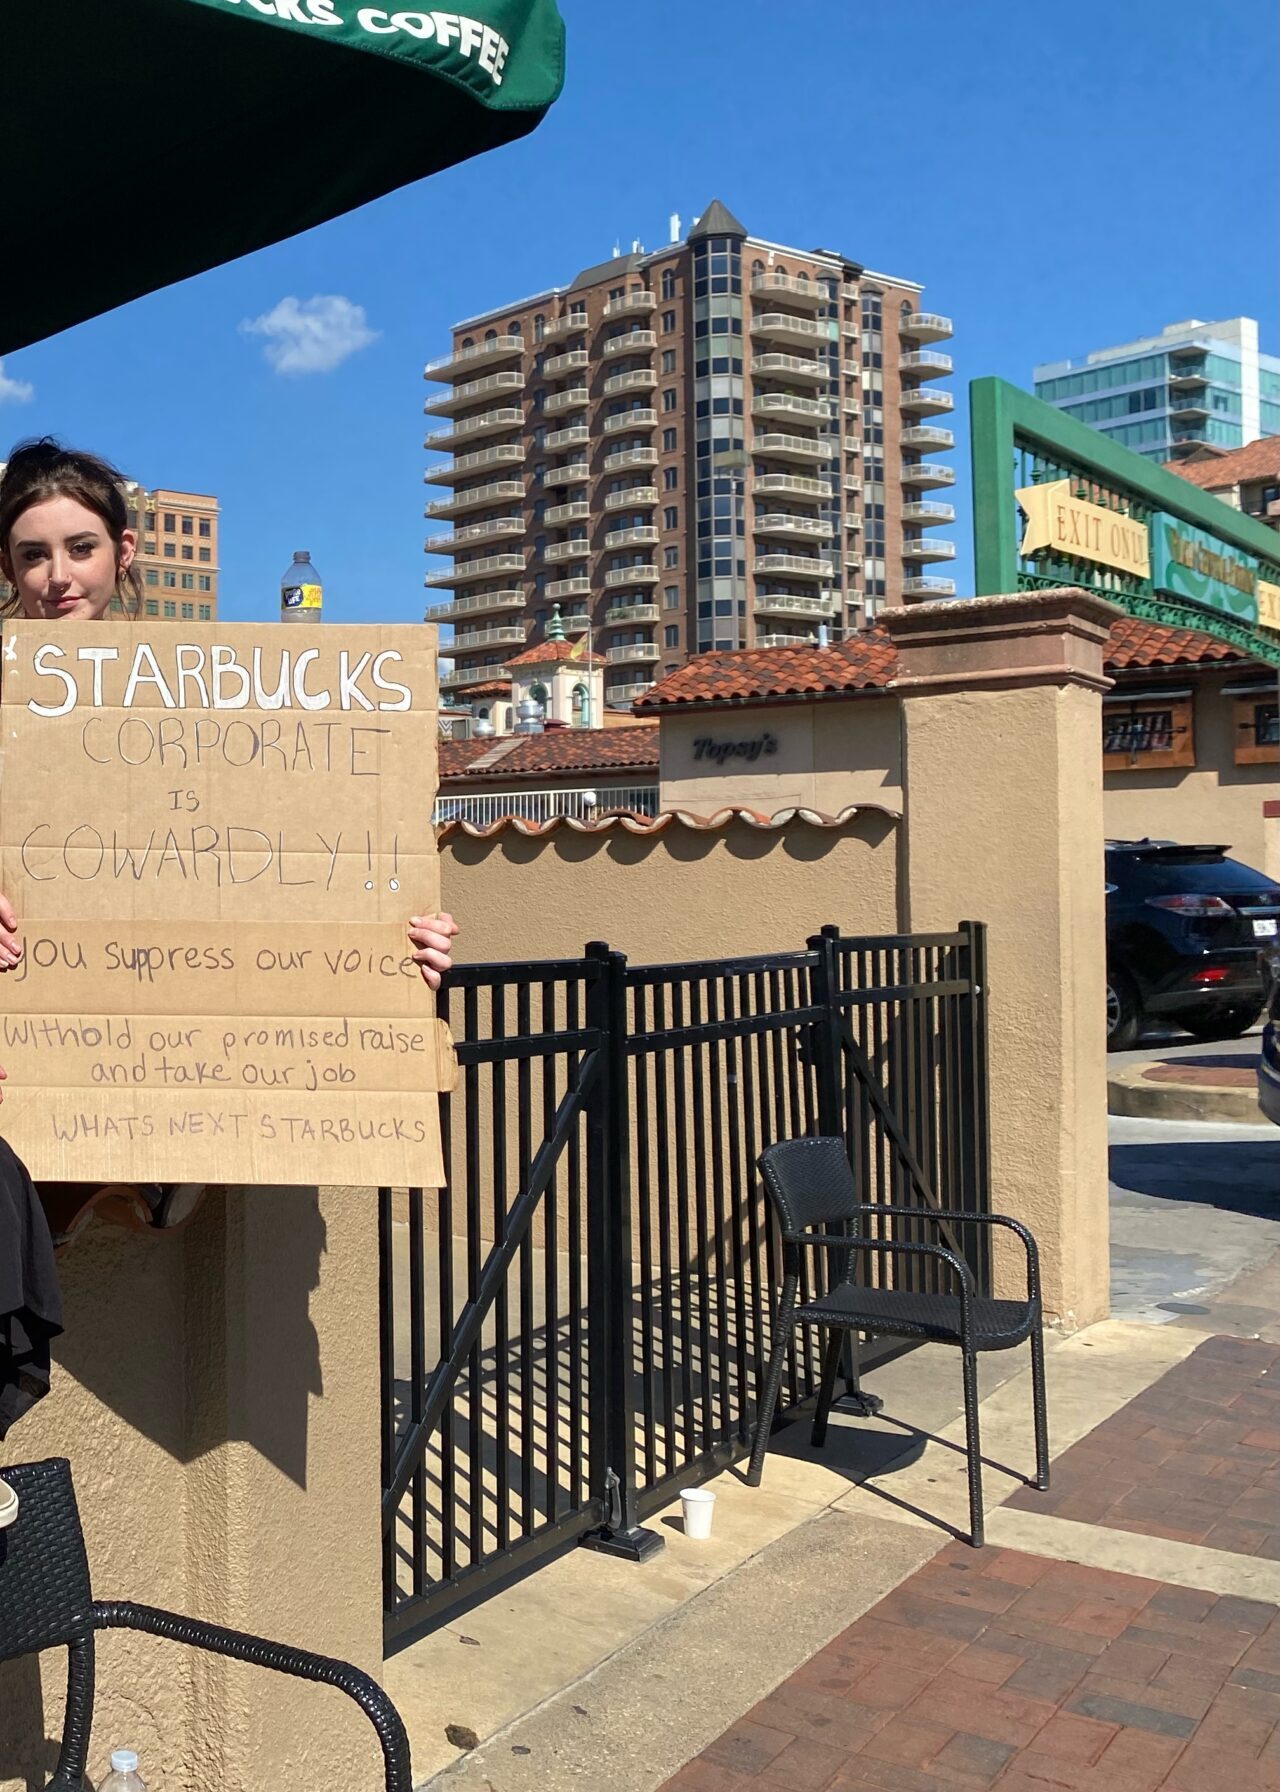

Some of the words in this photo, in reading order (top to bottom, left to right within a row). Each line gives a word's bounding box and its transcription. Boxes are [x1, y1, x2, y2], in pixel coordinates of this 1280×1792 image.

[226, 0, 345, 26] CKS
[357, 8, 510, 86] COFFEE
[1056, 504, 1102, 551] EXIT
[1258, 590, 1280, 622] EX
[27, 642, 412, 717] STARBUCKS
[81, 717, 392, 776] CORPORATE
[693, 732, 778, 765] Topsy's
[168, 789, 200, 812] IS
[14, 936, 87, 982] you
[256, 949, 312, 970] our
[149, 1029, 202, 1051] our
[223, 1016, 349, 1061] promised
[359, 1024, 426, 1053] raise
[91, 1053, 147, 1083] and
[154, 1056, 232, 1084] take
[242, 1063, 295, 1086] our
[305, 1059, 357, 1092] job
[52, 1113, 154, 1143] WHATS
[169, 1111, 249, 1139] NEXT
[260, 1113, 427, 1143] STARBUCKS
